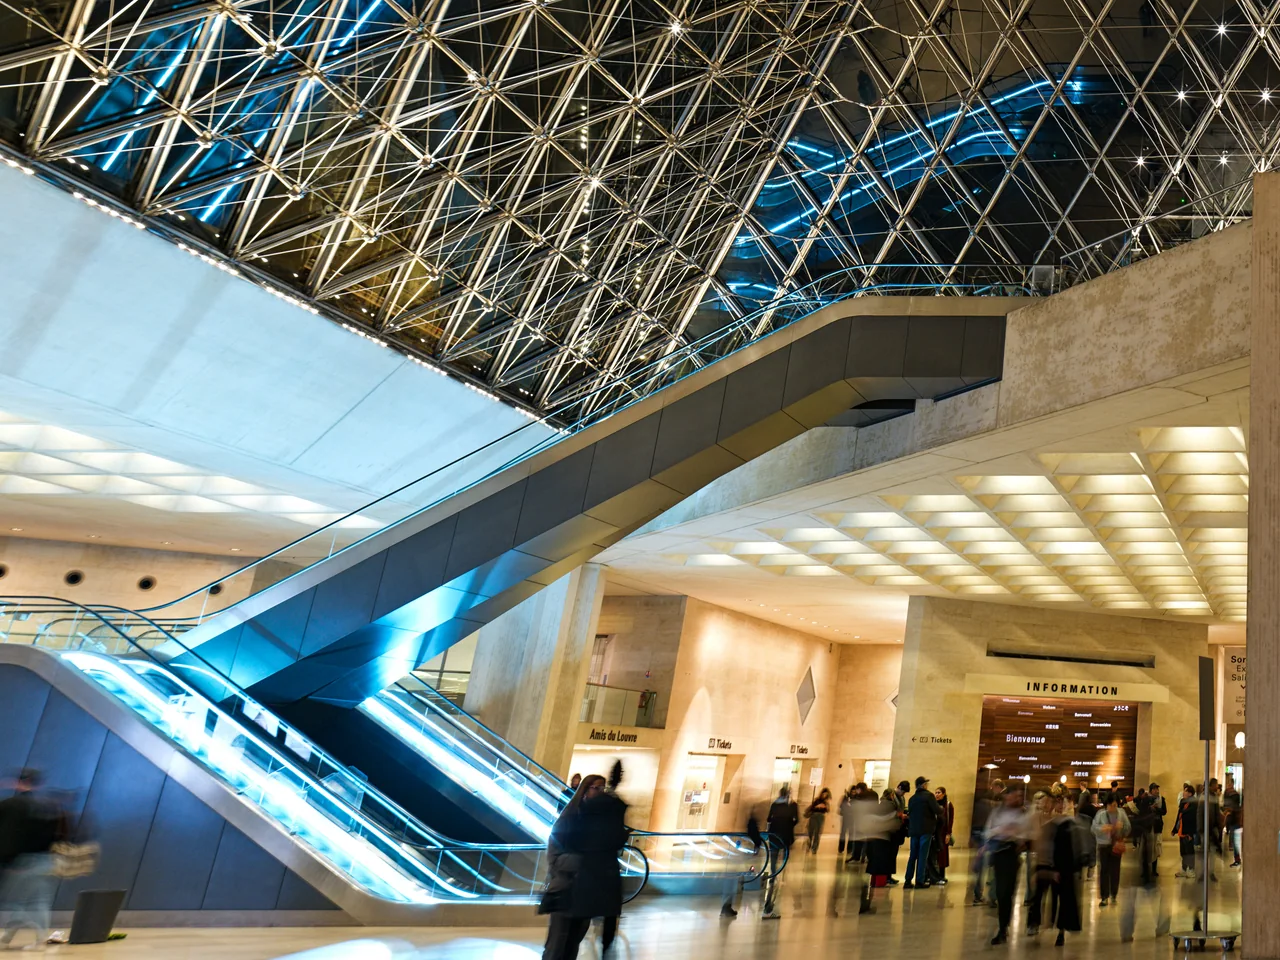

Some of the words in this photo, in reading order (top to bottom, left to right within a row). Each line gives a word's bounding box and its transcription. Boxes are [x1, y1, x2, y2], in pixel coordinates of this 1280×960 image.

[1026, 682, 1118, 695] INFORMATION
[589, 728, 606, 740] Amis
[607, 730, 616, 740] du
[617, 730, 637, 742] Louvre
[1006, 734, 1046, 743] Bienvenue
[717, 738, 732, 749] Tickets
